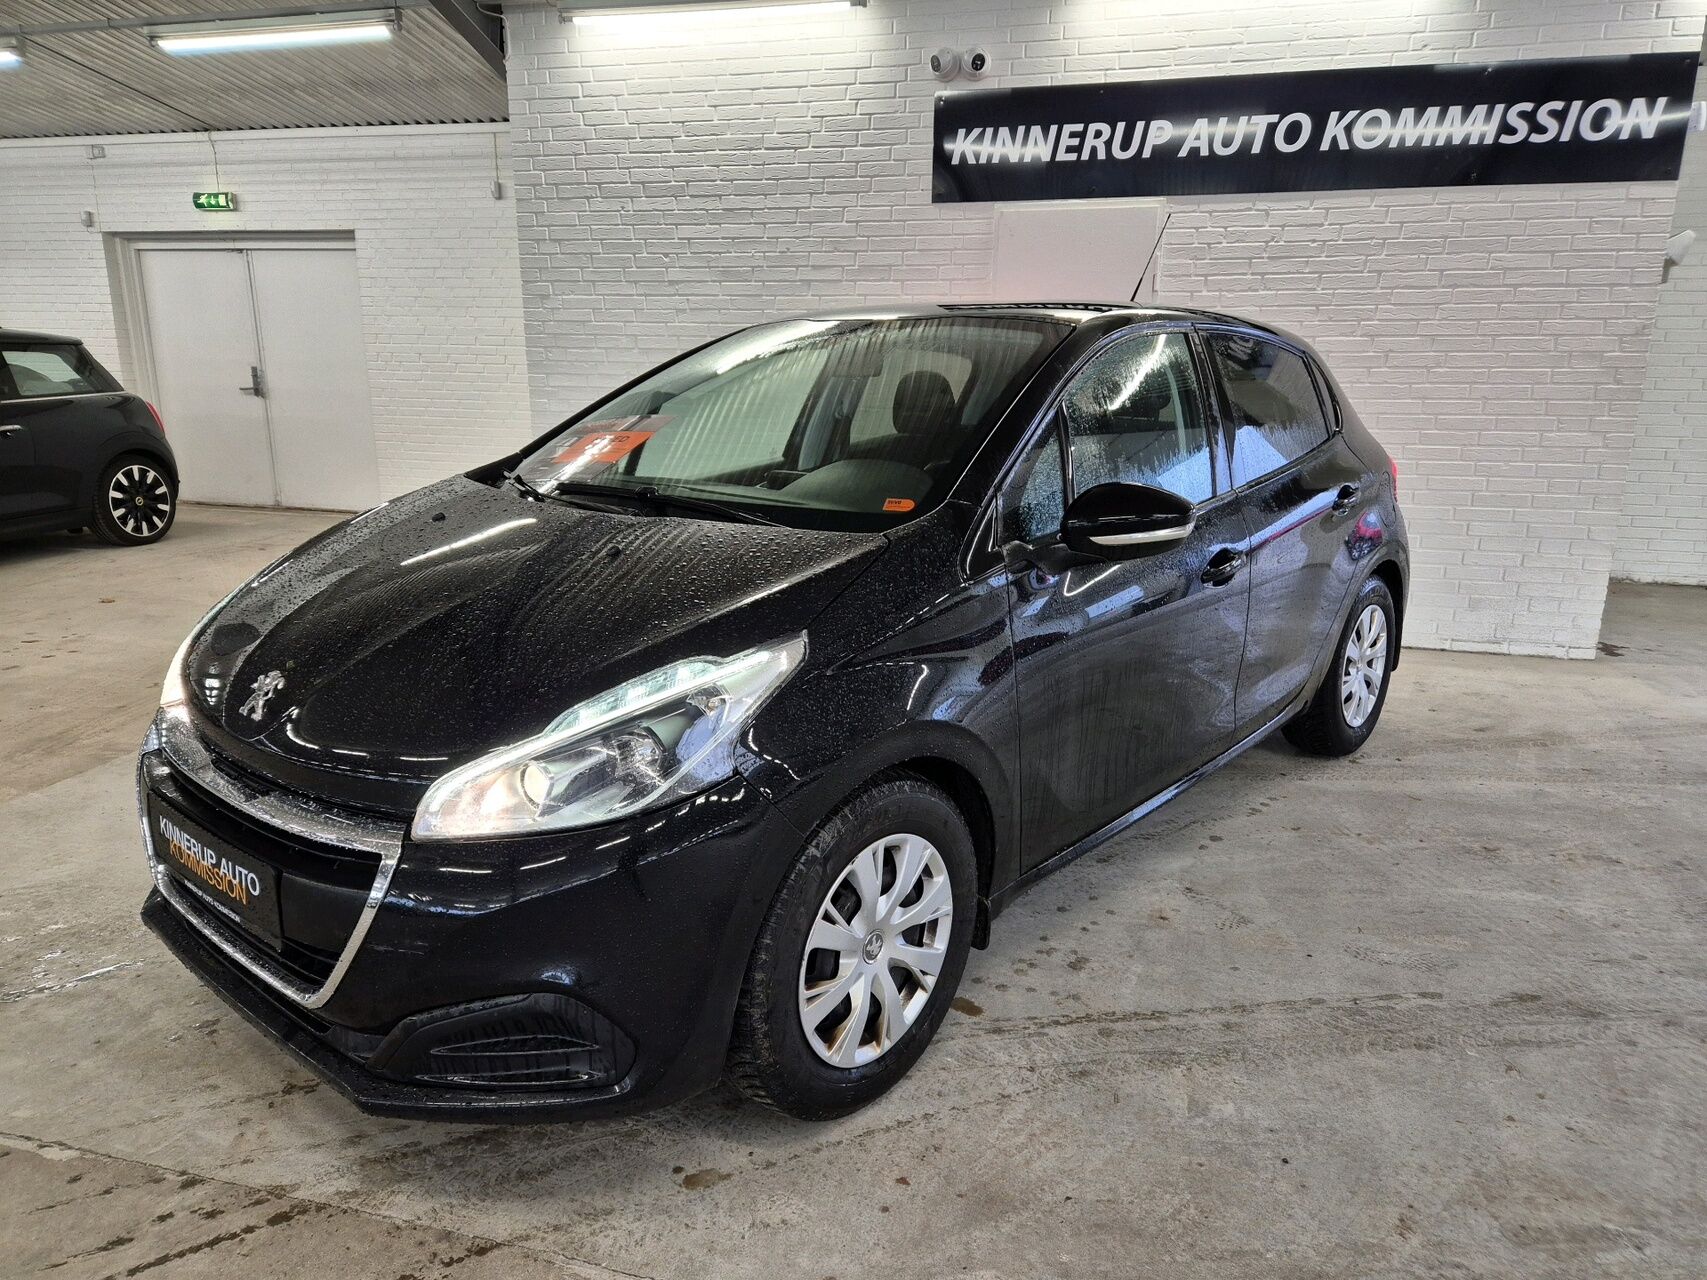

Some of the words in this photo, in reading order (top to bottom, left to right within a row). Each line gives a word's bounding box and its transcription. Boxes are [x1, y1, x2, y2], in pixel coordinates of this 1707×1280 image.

[950, 119, 1174, 166] KINNERUP
[1177, 112, 1312, 158] AUTO
[1319, 96, 1670, 152] KOMMISSION
[160, 815, 216, 866] KINNERUP
[219, 857, 260, 897] AUTO
[169, 840, 247, 905] KOMMISSION
